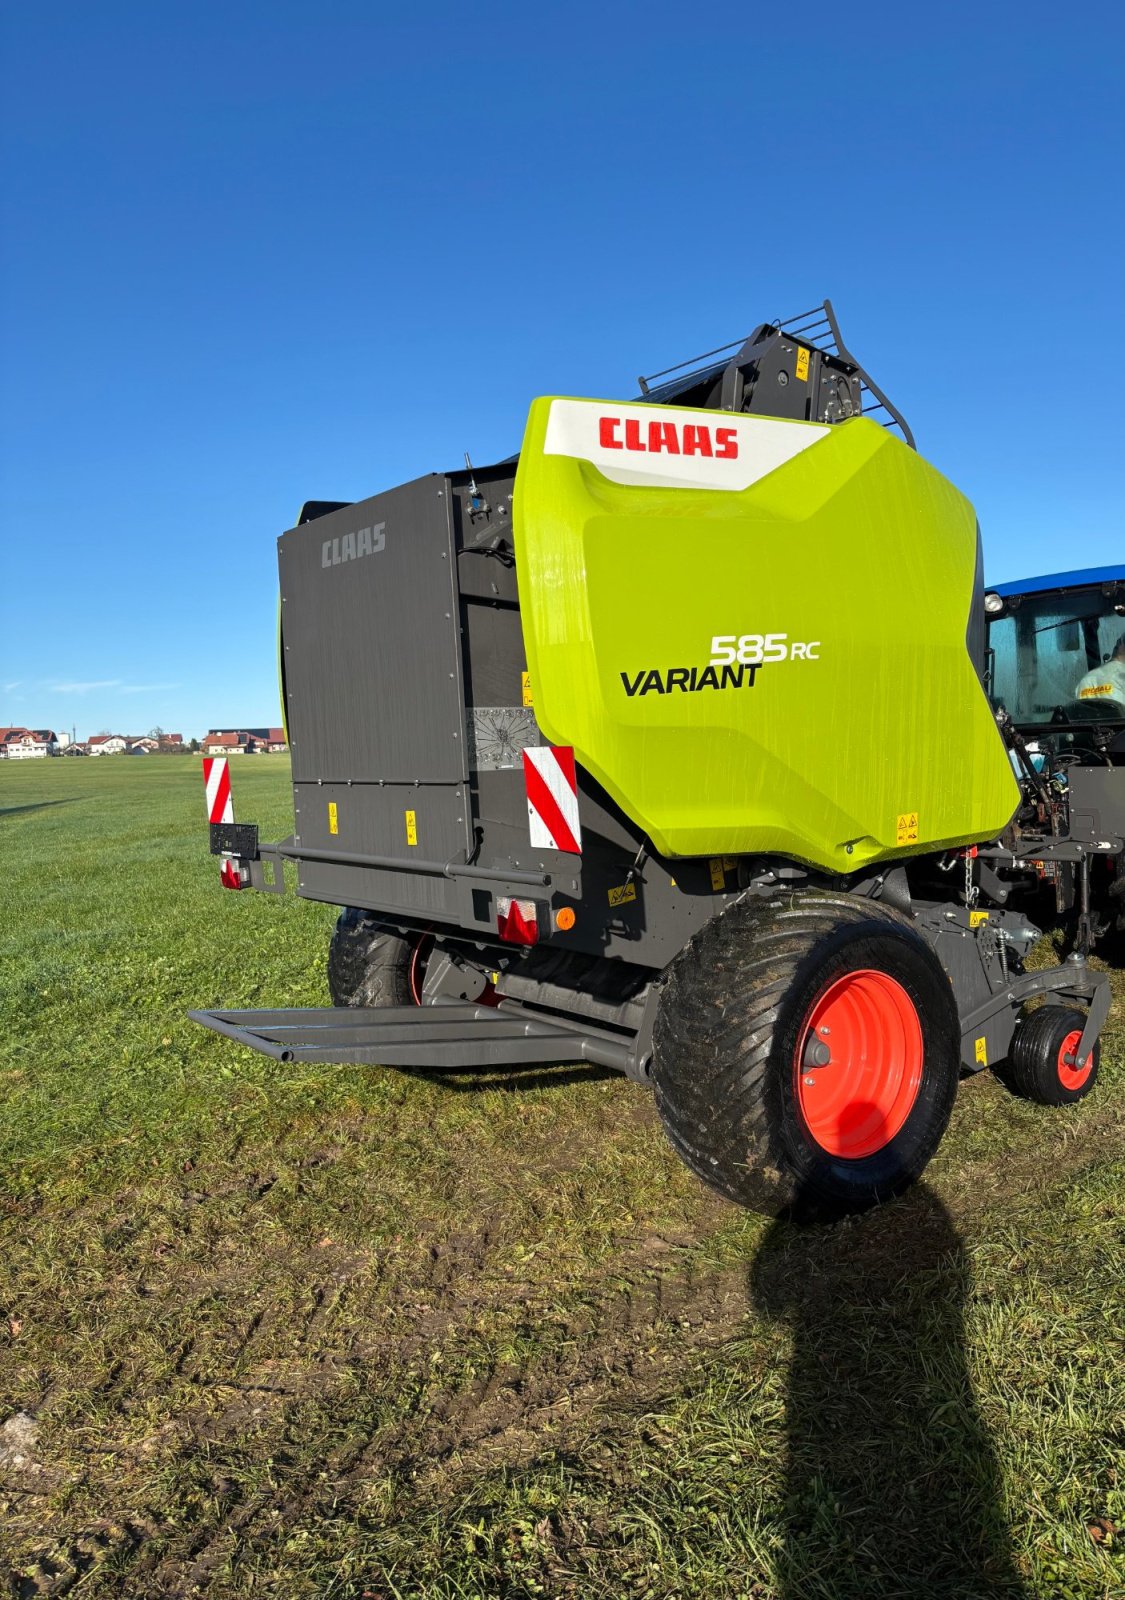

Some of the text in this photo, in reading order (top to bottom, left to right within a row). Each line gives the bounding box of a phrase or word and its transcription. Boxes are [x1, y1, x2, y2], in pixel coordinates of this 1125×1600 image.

[600, 417, 738, 459] CLAAS
[322, 521, 386, 568] CLAAS
[709, 633, 821, 666] 585 RC
[620, 663, 762, 697] VARIANT
